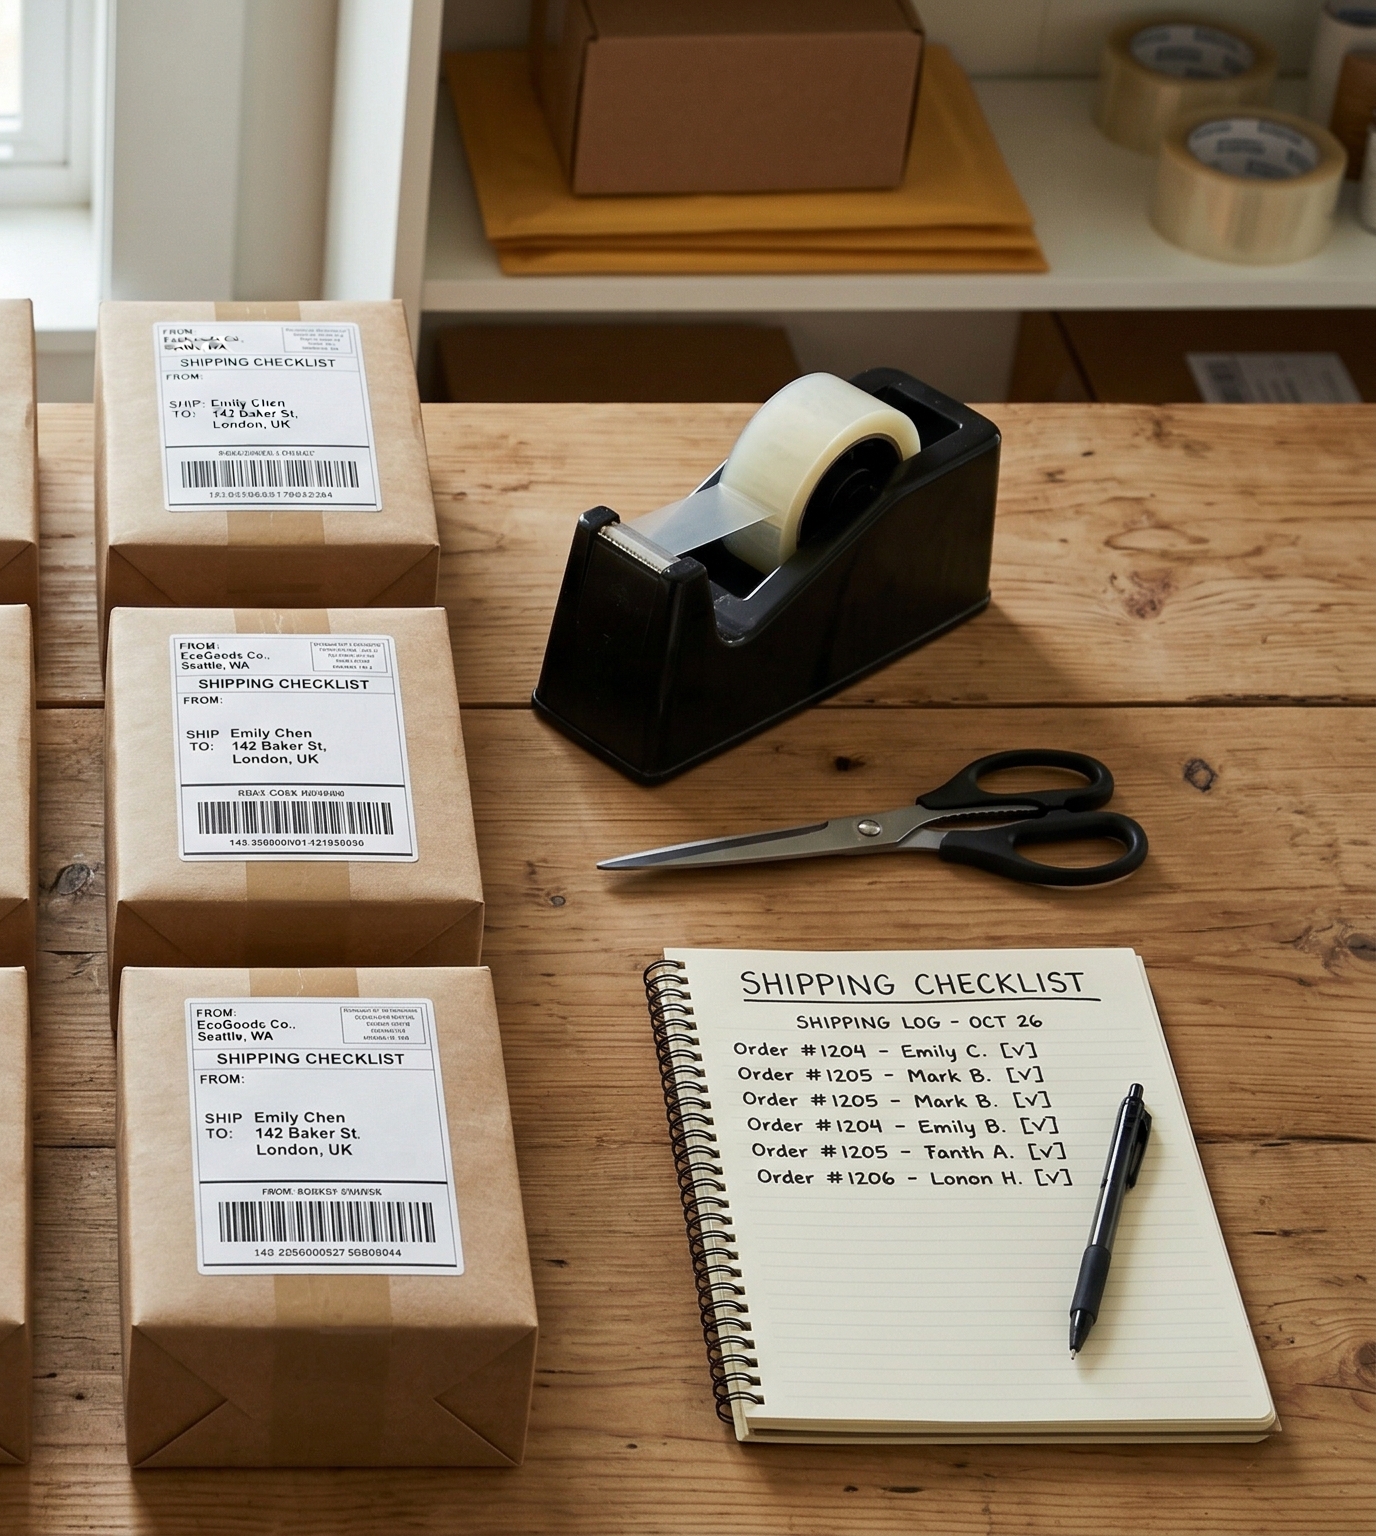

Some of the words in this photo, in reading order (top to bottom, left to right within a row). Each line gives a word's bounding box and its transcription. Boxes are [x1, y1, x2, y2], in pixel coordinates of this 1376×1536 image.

[181, 358, 248, 367] SHIPPING
[254, 358, 335, 367] CHECKLIST
[199, 679, 273, 689] SHIPPING
[279, 679, 369, 689] CHECKLIST
[231, 728, 270, 740] Emily
[275, 728, 311, 737] Chen
[233, 741, 256, 750] 142
[262, 741, 303, 750] Baker
[308, 741, 326, 752] St,
[233, 754, 292, 765] London,
[297, 754, 318, 763] UK
[741, 971, 894, 996] SHIPPING
[915, 972, 1084, 995] CHECKLIST
[197, 1009, 236, 1017] FROM:
[797, 1016, 890, 1029] SHIPPING
[902, 1016, 940, 1029] LOG
[969, 1016, 1006, 1028] OCT
[1017, 1015, 1042, 1027] 26
[251, 1031, 273, 1040] WA
[734, 1042, 788, 1056] Order
[801, 1044, 866, 1058] #1204
[901, 1045, 957, 1062] Emily
[966, 1044, 986, 1058] C.
[217, 1053, 299, 1064] SHIPPING
[306, 1053, 404, 1064] CHECKLIST
[200, 1074, 244, 1084] FROM:
[738, 1067, 794, 1081] Order
[806, 1069, 872, 1082] #1205
[908, 1069, 961, 1082] Mark
[969, 1068, 991, 1082] B.
[743, 1092, 798, 1106] Order
[811, 1094, 878, 1107] #1205
[914, 1095, 968, 1108] Mark
[975, 1094, 997, 1108] B.
[205, 1113, 242, 1124] SHIP
[255, 1112, 298, 1125] Emily
[304, 1112, 345, 1123] Chen
[206, 1128, 232, 1139] TO:
[256, 1127, 283, 1138] 142
[289, 1127, 335, 1139] Baker
[748, 1117, 803, 1132] Order
[816, 1119, 882, 1133] #1204
[918, 1120, 976, 1138] Emily
[985, 1119, 1005, 1133] B.
[257, 1144, 323, 1157] London,
[329, 1144, 352, 1155] UK
[752, 1143, 808, 1157] Order
[821, 1145, 887, 1159] #1205
[994, 1145, 1014, 1158] A.
[758, 1169, 814, 1184] Order
[827, 1172, 895, 1185] #1206
[931, 1172, 993, 1185] Lonon
[1001, 1171, 1022, 1185] H.
